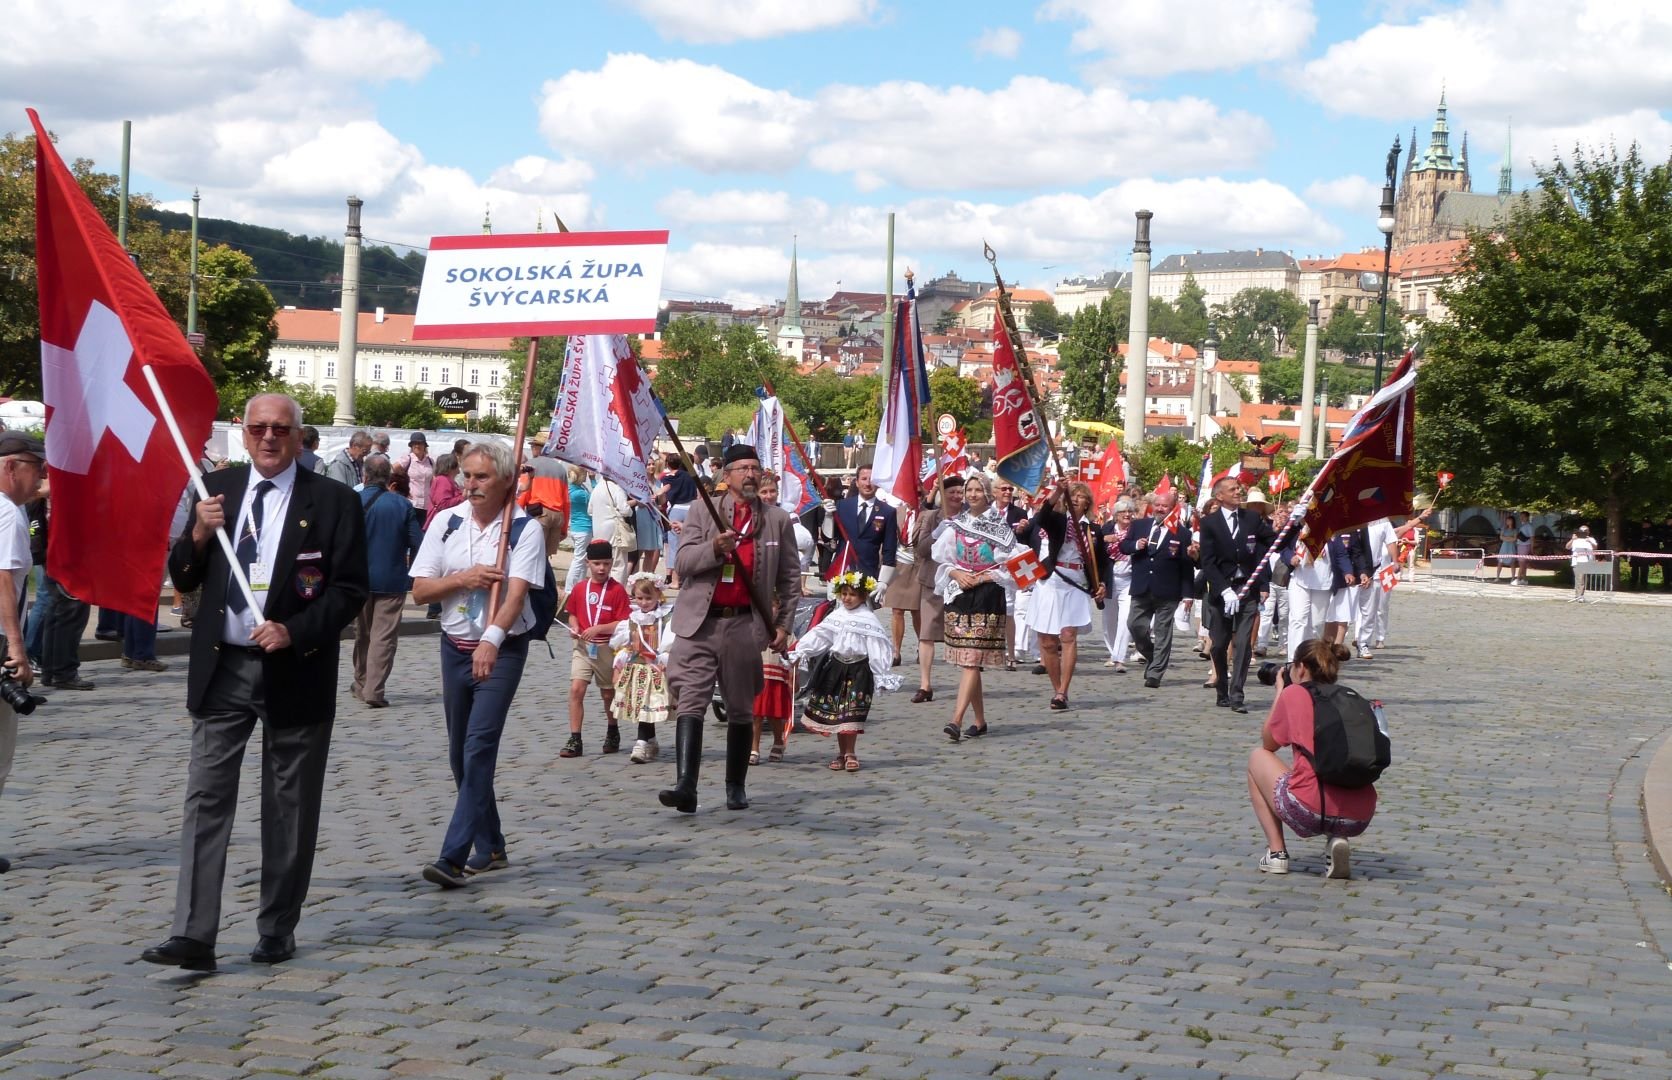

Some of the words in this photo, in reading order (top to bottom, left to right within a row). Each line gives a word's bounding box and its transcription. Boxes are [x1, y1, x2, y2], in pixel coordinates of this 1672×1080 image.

[445, 260, 573, 283] SOKOLSKÁ
[580, 259, 644, 279] ŽUPA
[468, 283, 609, 307] ŠVÝCARSKÁ
